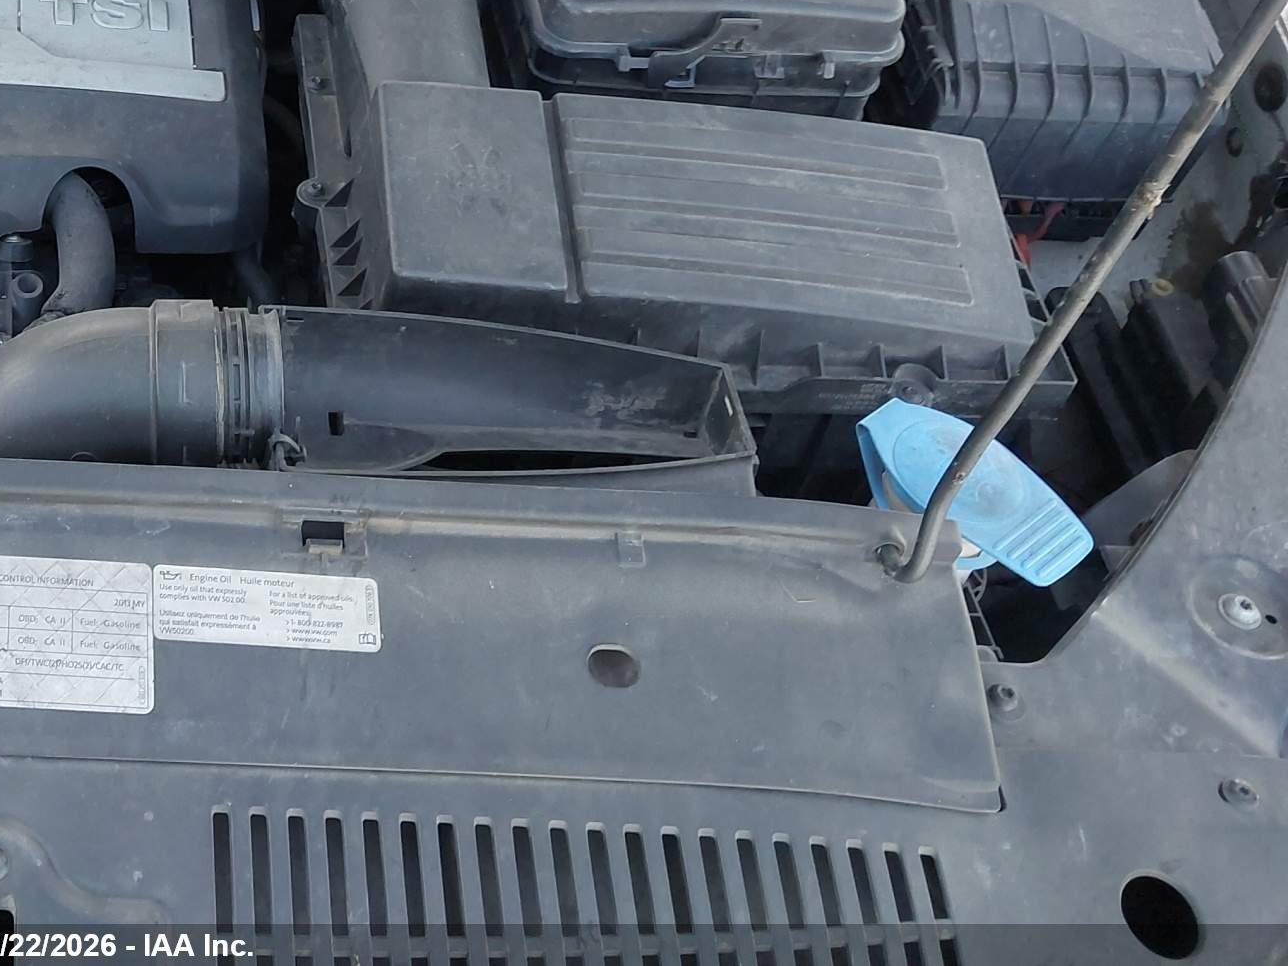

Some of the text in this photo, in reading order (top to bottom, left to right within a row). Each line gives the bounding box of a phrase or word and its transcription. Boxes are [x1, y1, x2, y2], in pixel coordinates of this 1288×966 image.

[37, 576, 94, 586] INFORMATION
[190, 574, 294, 588] Engine Oil Huile moteur
[174, 584, 188, 594] only
[215, 588, 247, 596] expressly
[160, 593, 190, 602] complies
[208, 595, 221, 603] VW
[308, 593, 340, 602] approved
[44, 616, 56, 624] CA
[103, 619, 141, 629] Gasoline
[44, 637, 56, 646] CA
[103, 641, 142, 652] Gasoline
